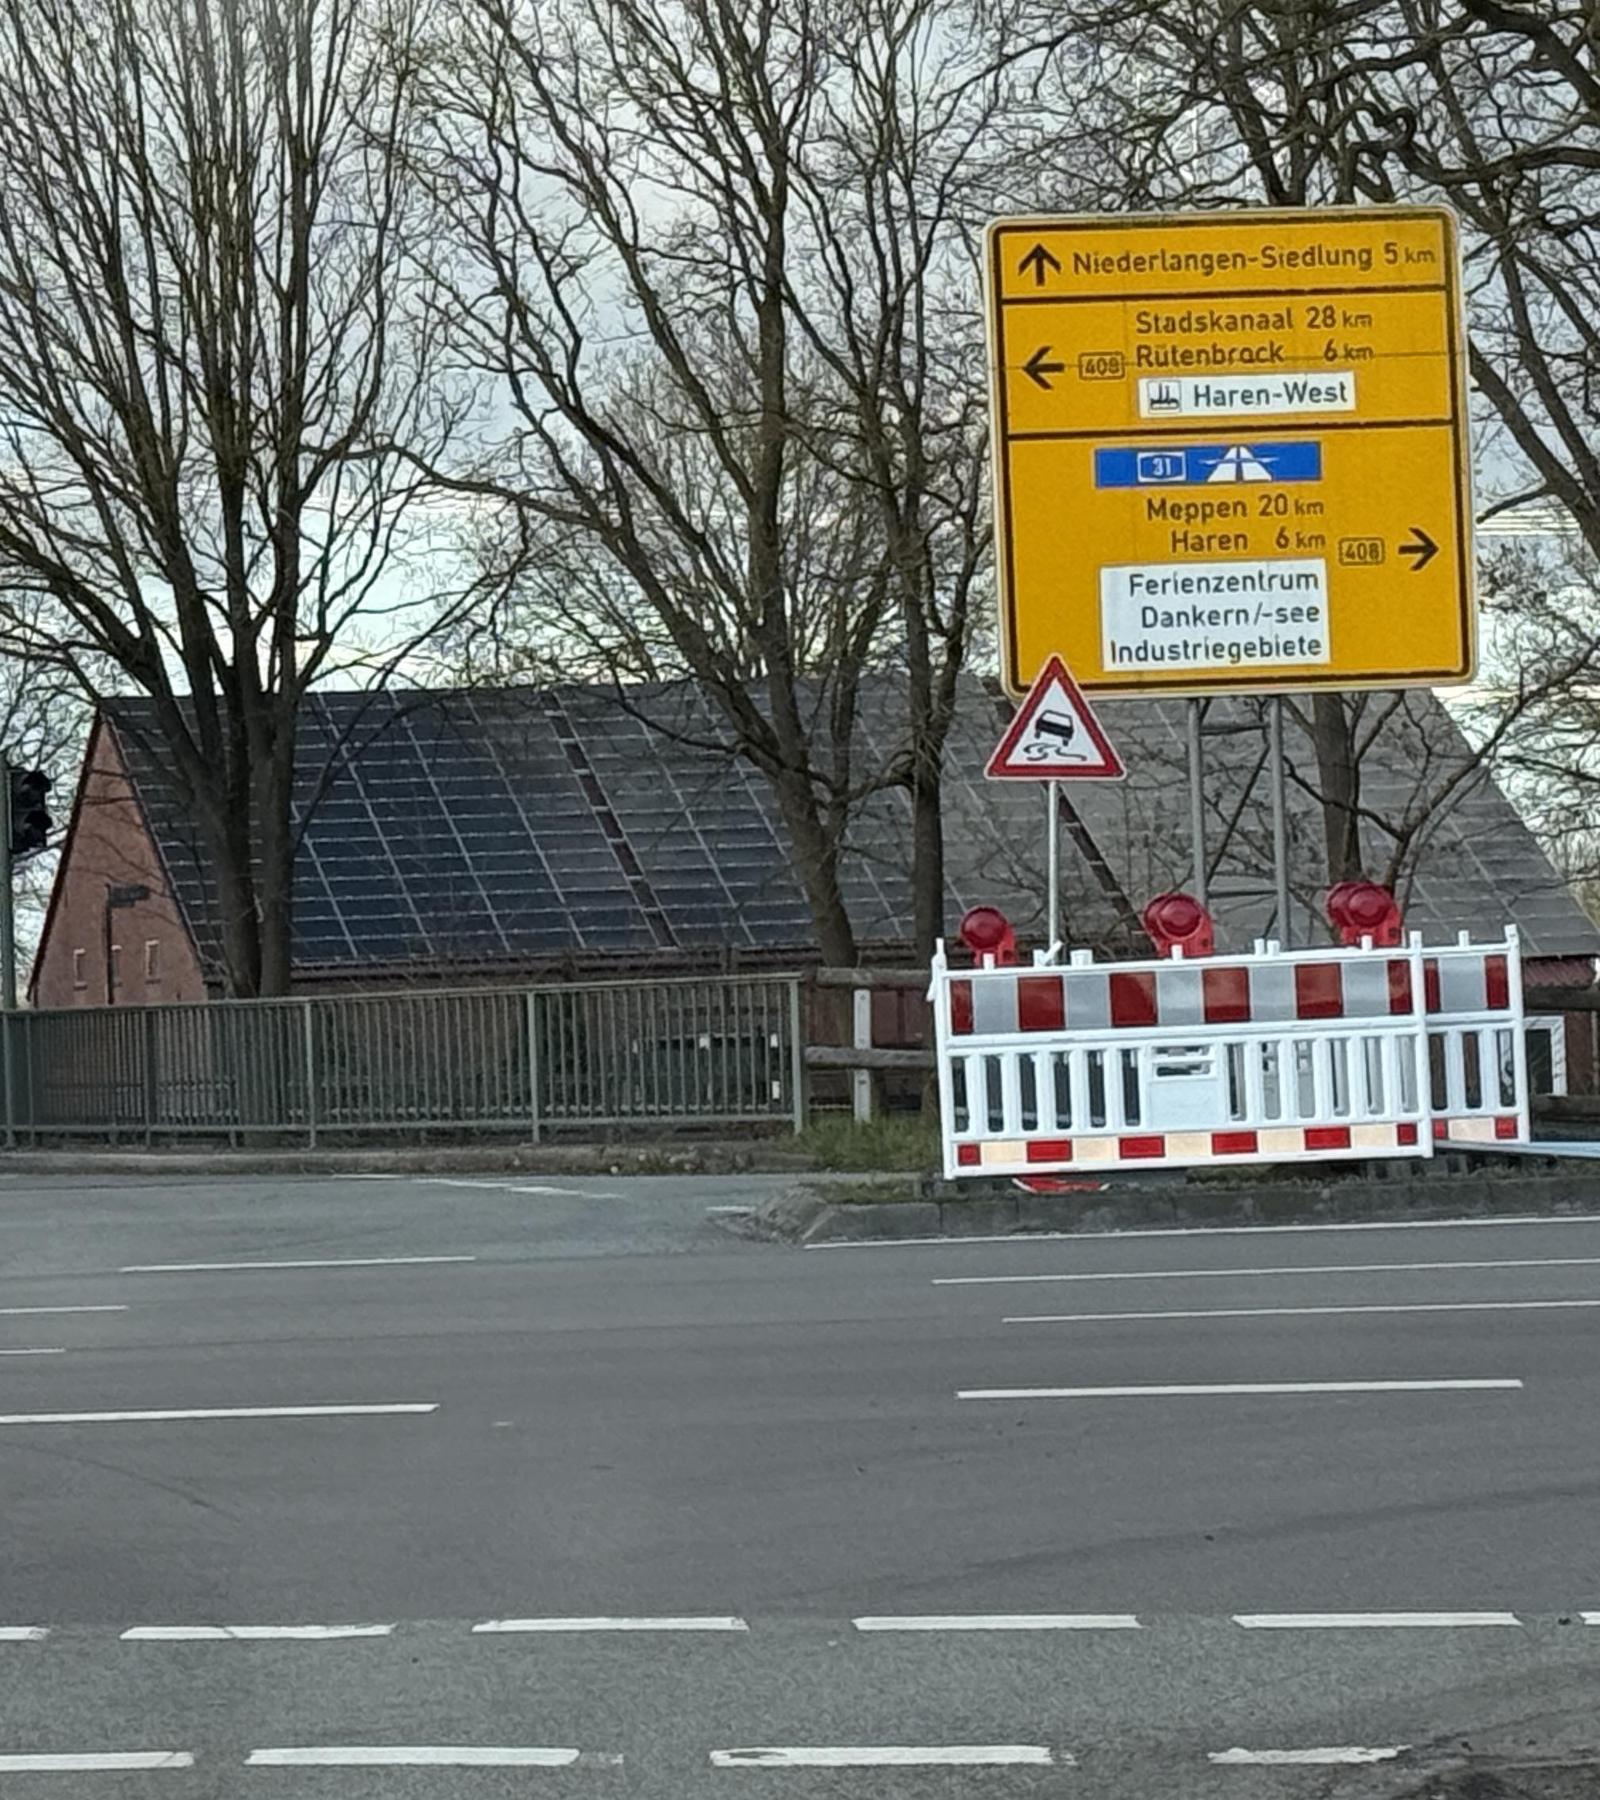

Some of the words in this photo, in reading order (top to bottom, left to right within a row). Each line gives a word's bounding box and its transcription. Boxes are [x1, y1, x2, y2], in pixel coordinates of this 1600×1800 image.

[1073, 243, 1373, 277] Niederlangen-Siedlung
[1384, 243, 1399, 265] 5
[1405, 246, 1436, 265] km
[1136, 307, 1294, 335] Stadskanaal
[1305, 305, 1336, 330] 28
[1342, 310, 1373, 329] km
[1323, 339, 1338, 362] 6
[1343, 343, 1374, 361] km
[1084, 356, 1120, 376] 408
[1193, 380, 1348, 408] Haren-West
[1152, 457, 1173, 476] 31
[1147, 498, 1248, 526] Meppen
[1258, 494, 1288, 517] 20
[1294, 497, 1325, 516] km
[1171, 530, 1248, 554] Haren
[1275, 526, 1290, 550] 6
[1295, 530, 1327, 550] km
[1344, 543, 1380, 561] 408
[1129, 571, 1320, 597] Ferienzentrum
[1110, 635, 1323, 665] Industriegebiete
